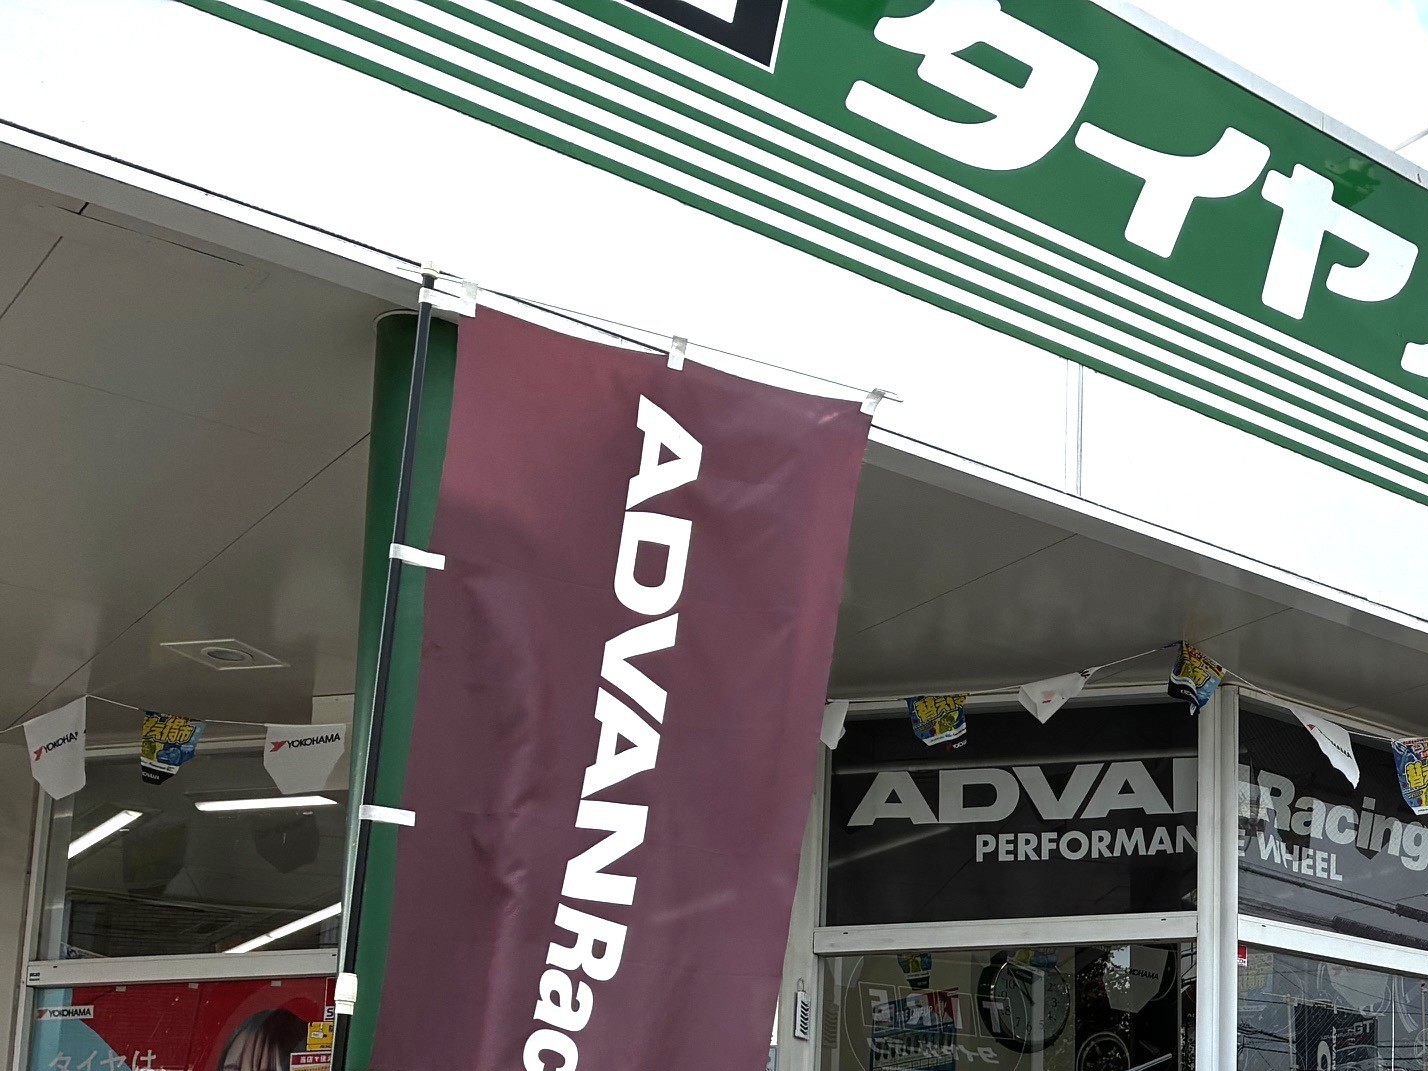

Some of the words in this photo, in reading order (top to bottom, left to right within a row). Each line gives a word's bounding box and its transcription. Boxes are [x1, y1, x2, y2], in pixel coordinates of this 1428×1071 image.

[42, 729, 87, 753] YOKOHA
[287, 733, 341, 749] YOKOHAMA
[975, 825, 1246, 862] PERFORMANE
[1256, 831, 1343, 881] WHEEL
[49, 1007, 92, 1017] YOKOHAMA
